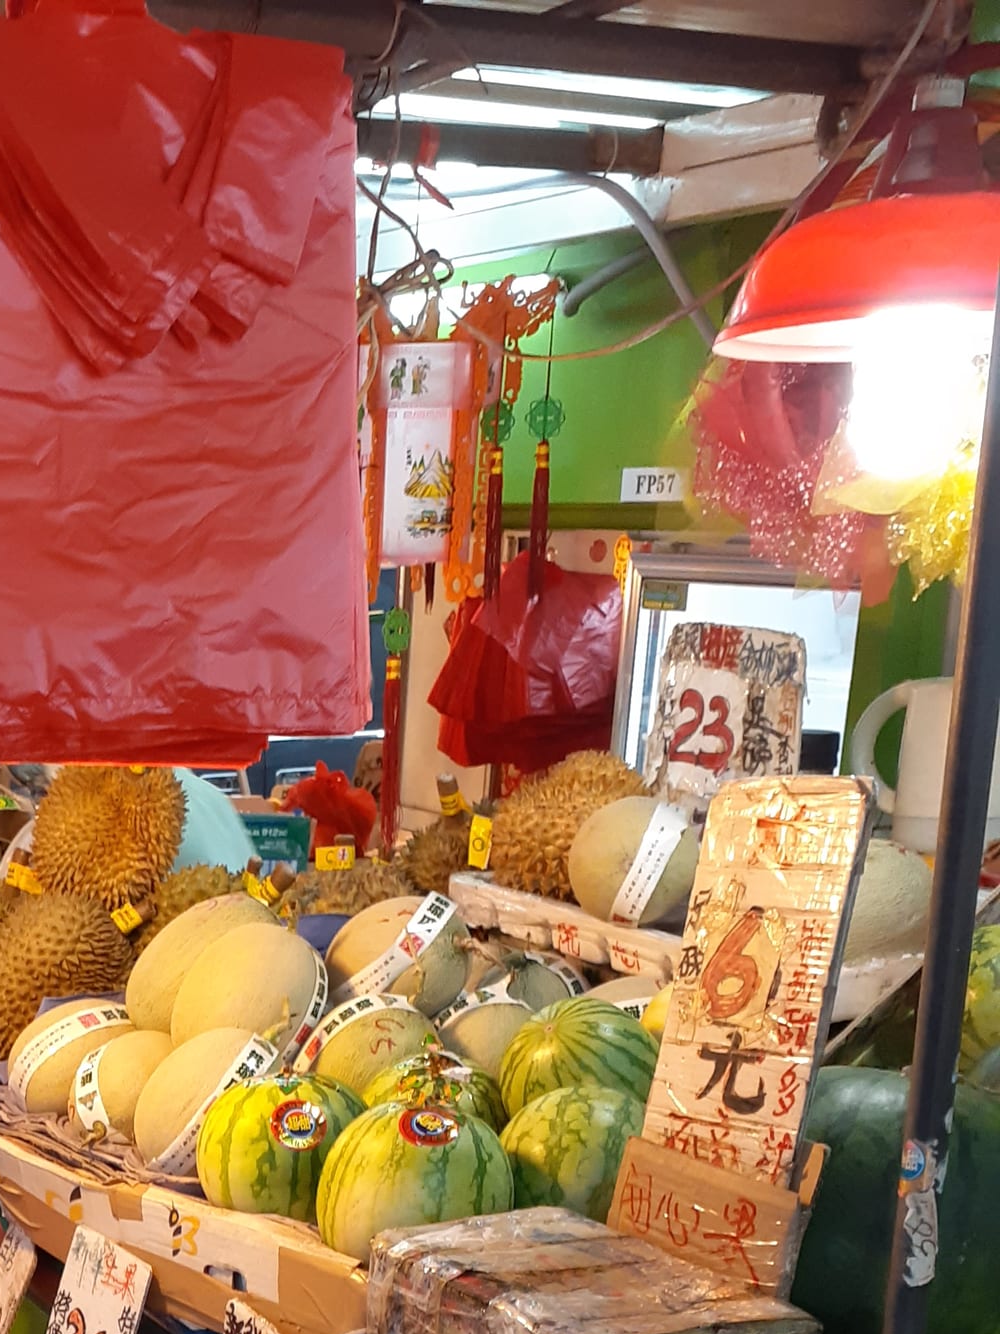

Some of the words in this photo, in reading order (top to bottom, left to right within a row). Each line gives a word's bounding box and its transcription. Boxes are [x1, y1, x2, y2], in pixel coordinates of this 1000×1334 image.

[636, 474, 676, 495] FP57
[669, 688, 735, 777] 23
[702, 906, 762, 1018] 6
